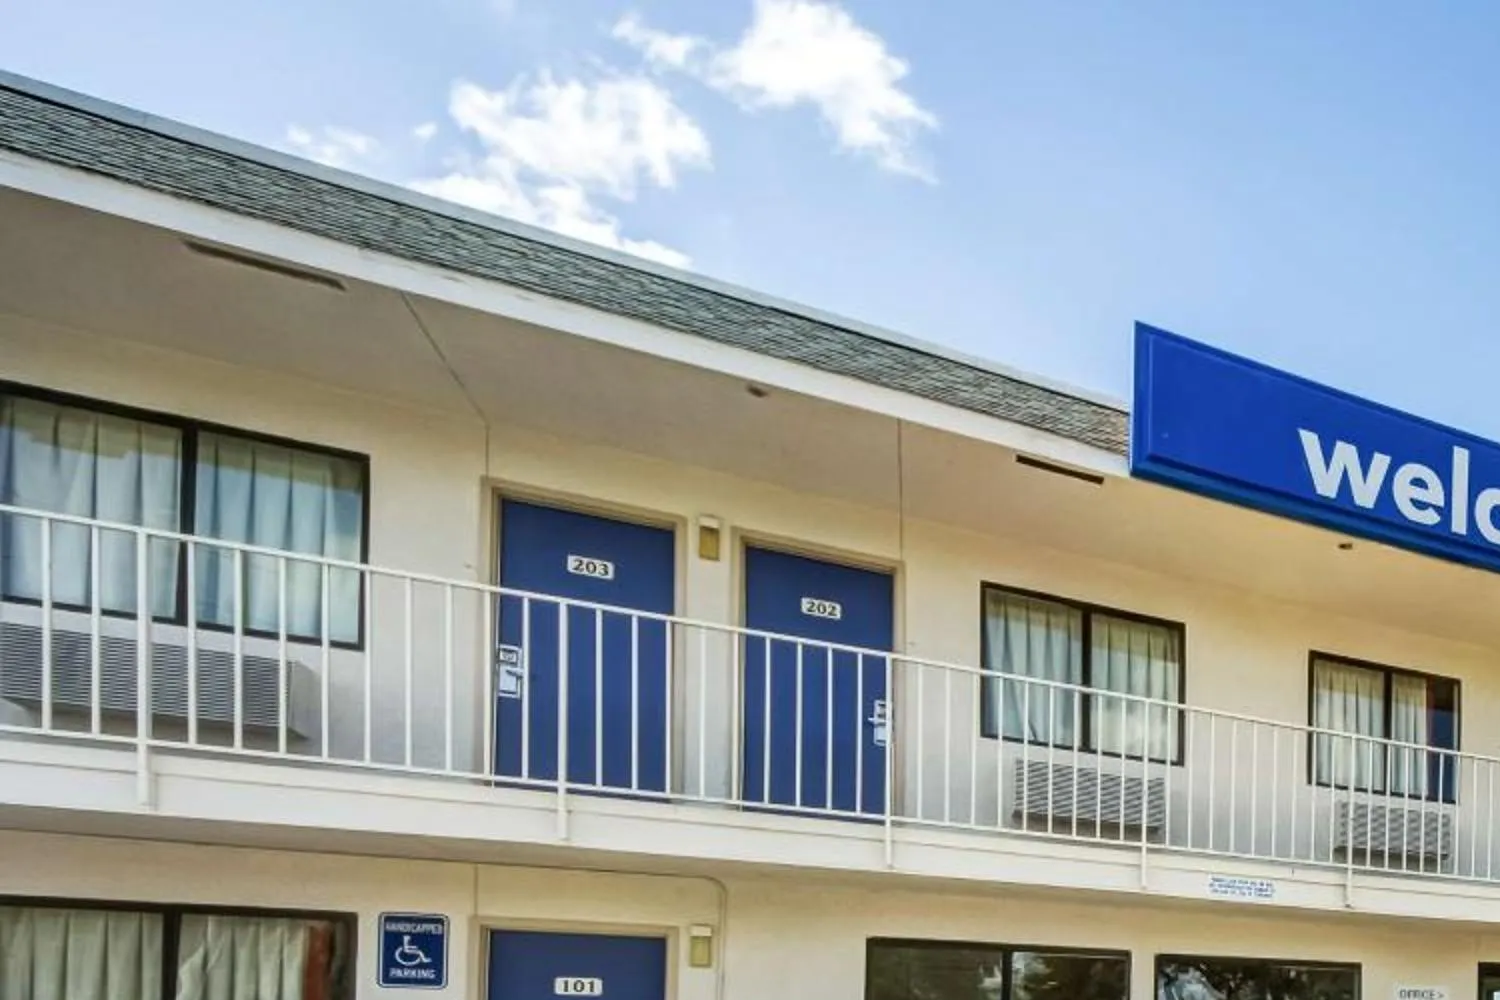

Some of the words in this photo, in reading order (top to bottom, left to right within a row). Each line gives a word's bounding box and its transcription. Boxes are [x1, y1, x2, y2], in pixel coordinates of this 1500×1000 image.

[572, 558, 609, 577] 203
[806, 601, 838, 616] 202
[386, 921, 442, 934] HANDICAPPED
[390, 967, 436, 979] PARKING
[562, 980, 595, 993] 101
[1399, 988, 1436, 1000] OFFICE
